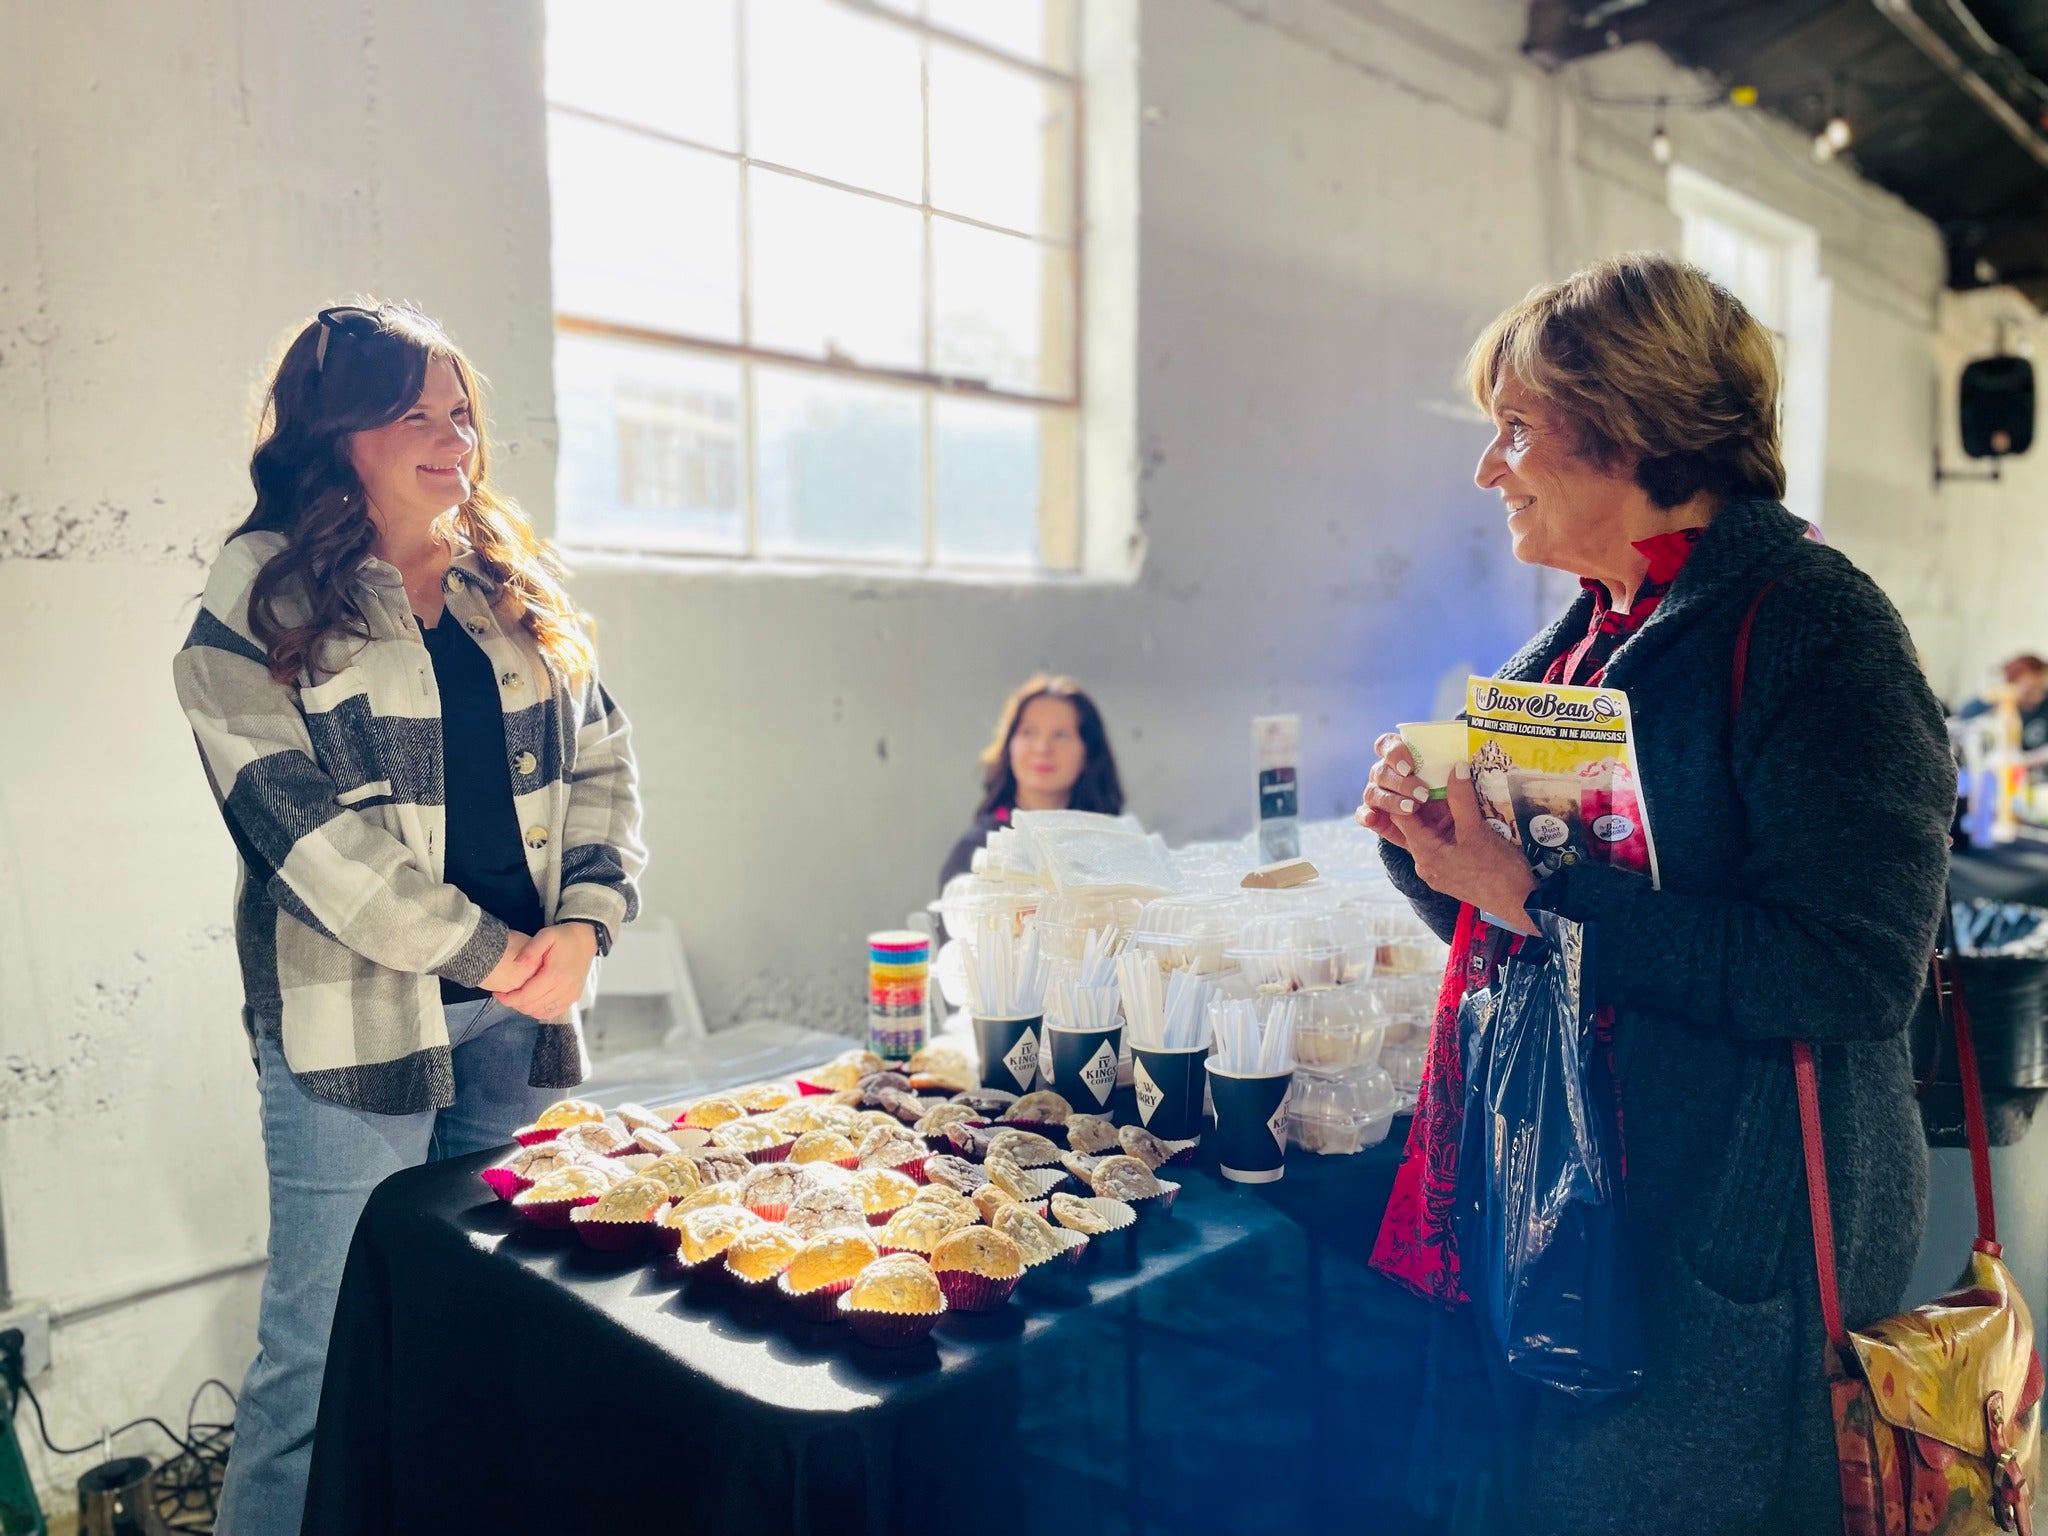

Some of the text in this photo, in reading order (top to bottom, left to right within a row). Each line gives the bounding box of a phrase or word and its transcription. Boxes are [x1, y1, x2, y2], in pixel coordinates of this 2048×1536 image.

[1528, 694, 1594, 721] Bean
[1471, 716, 1626, 742] NOW WITH SEVEN LOCATIONS IN NE ARKANSAS!
[1021, 1045, 1033, 1055] IV
[1098, 1059, 1110, 1069] IV
[1086, 1065, 1117, 1079] KINGS
